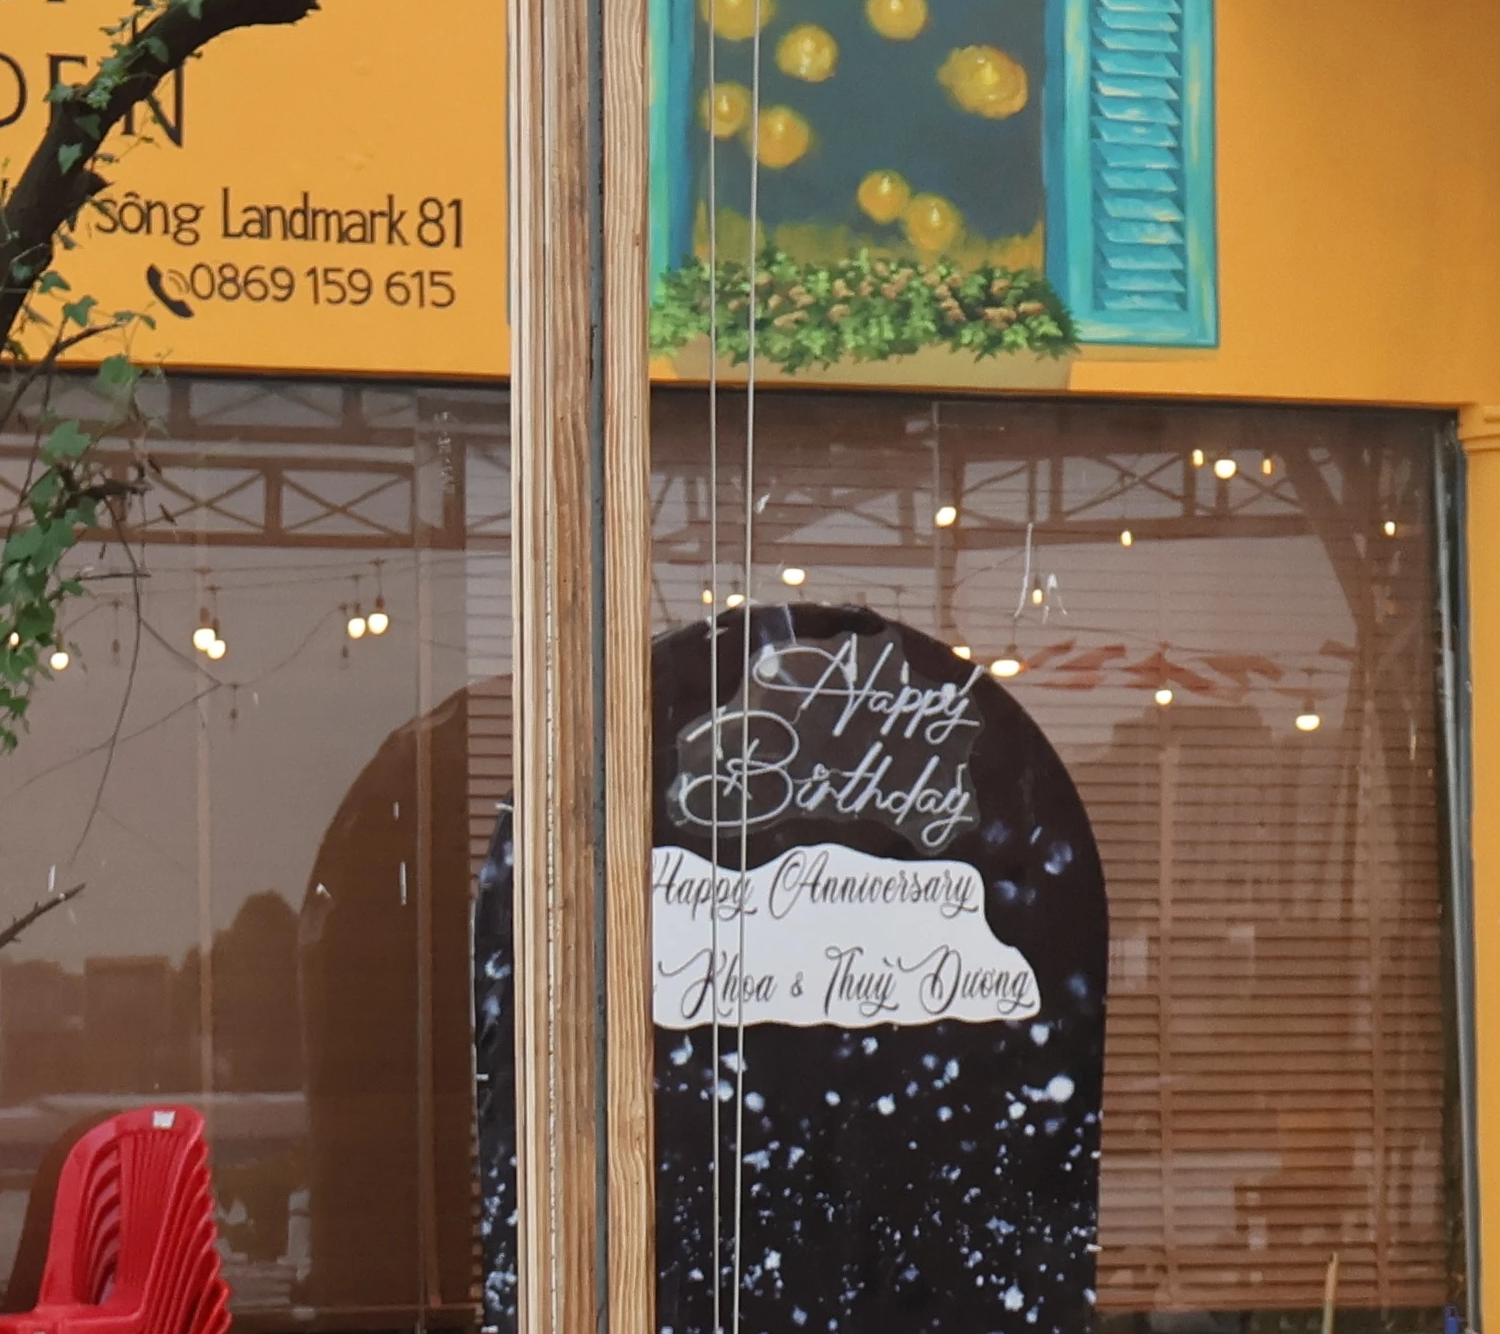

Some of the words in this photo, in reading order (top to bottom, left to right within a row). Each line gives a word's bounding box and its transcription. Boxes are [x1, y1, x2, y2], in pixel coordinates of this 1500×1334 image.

[95, 190, 205, 246] sông
[221, 186, 409, 247] Landmark
[416, 197, 464, 248] 81
[190, 263, 295, 302] 0869
[305, 266, 374, 305] 159
[385, 269, 457, 309] 615
[751, 632, 983, 745] Happy
[678, 710, 975, 848] Birthday
[653, 851, 758, 921] Happy
[768, 849, 981, 919] Anniversary
